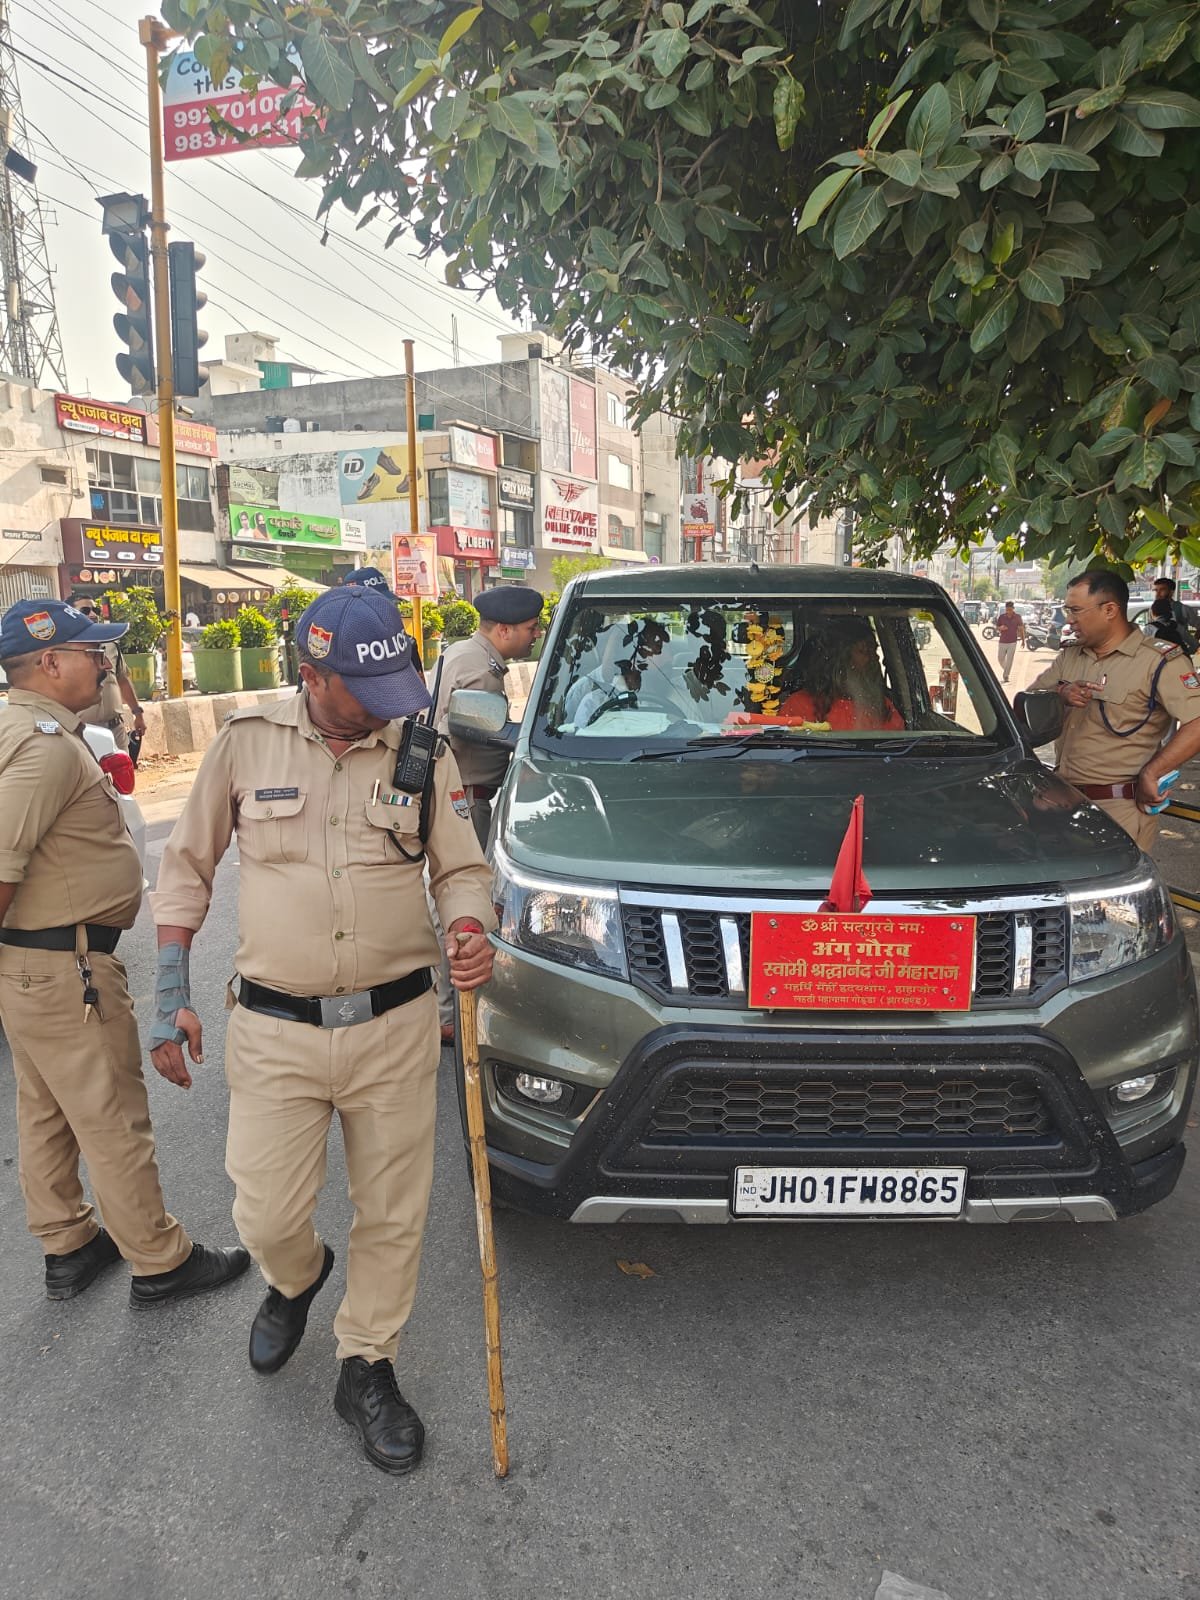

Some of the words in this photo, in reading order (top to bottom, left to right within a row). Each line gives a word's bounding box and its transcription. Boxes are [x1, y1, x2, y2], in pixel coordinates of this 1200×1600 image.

[194, 76, 235, 94] this
[109, 411, 120, 424] दा
[545, 504, 598, 526] REDTAPE
[86, 527, 104, 547] न्यू
[130, 531, 141, 543] दा
[545, 521, 571, 534] ONLINE
[573, 525, 597, 537] OUTLET
[467, 535, 494, 550] LIBERTY
[801, 918, 819, 933] ॐ
[820, 917, 838, 933] श्री
[856, 938, 913, 958] गौरव
[762, 958, 808, 978] स्वामी
[811, 960, 872, 981] श्रद्धानंद
[874, 960, 894, 979] जी
[897, 963, 960, 981] महाराज
[739, 1186, 757, 1195] IND
